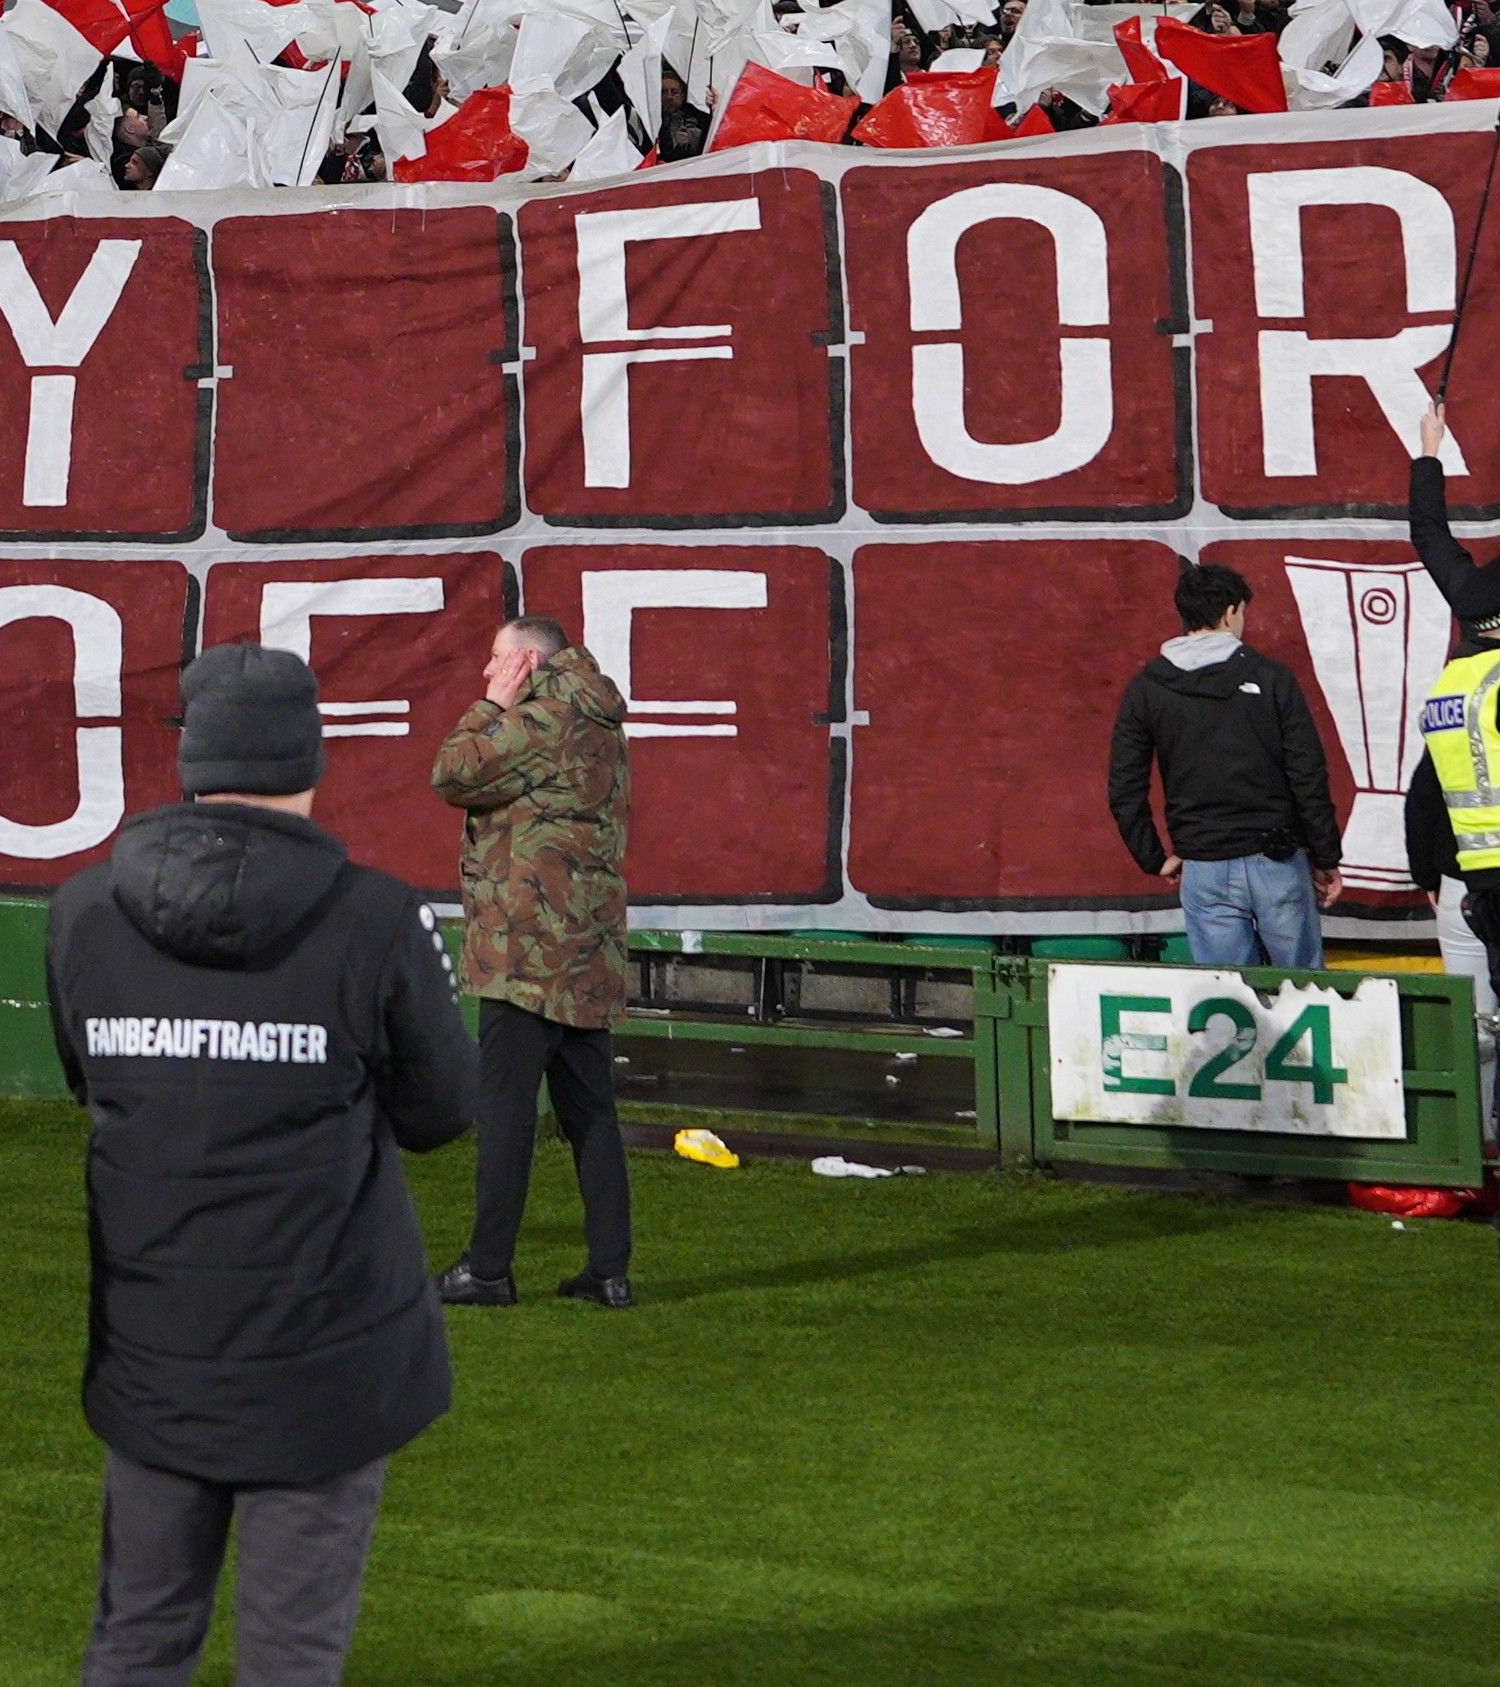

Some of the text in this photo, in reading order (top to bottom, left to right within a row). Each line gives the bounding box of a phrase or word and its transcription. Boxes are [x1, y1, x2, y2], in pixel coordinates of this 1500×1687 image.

[576, 165, 1468, 490] FOR
[85, 1016, 328, 1064] FANBEAUFTRAGTER
[1099, 994, 1349, 1106] E24
